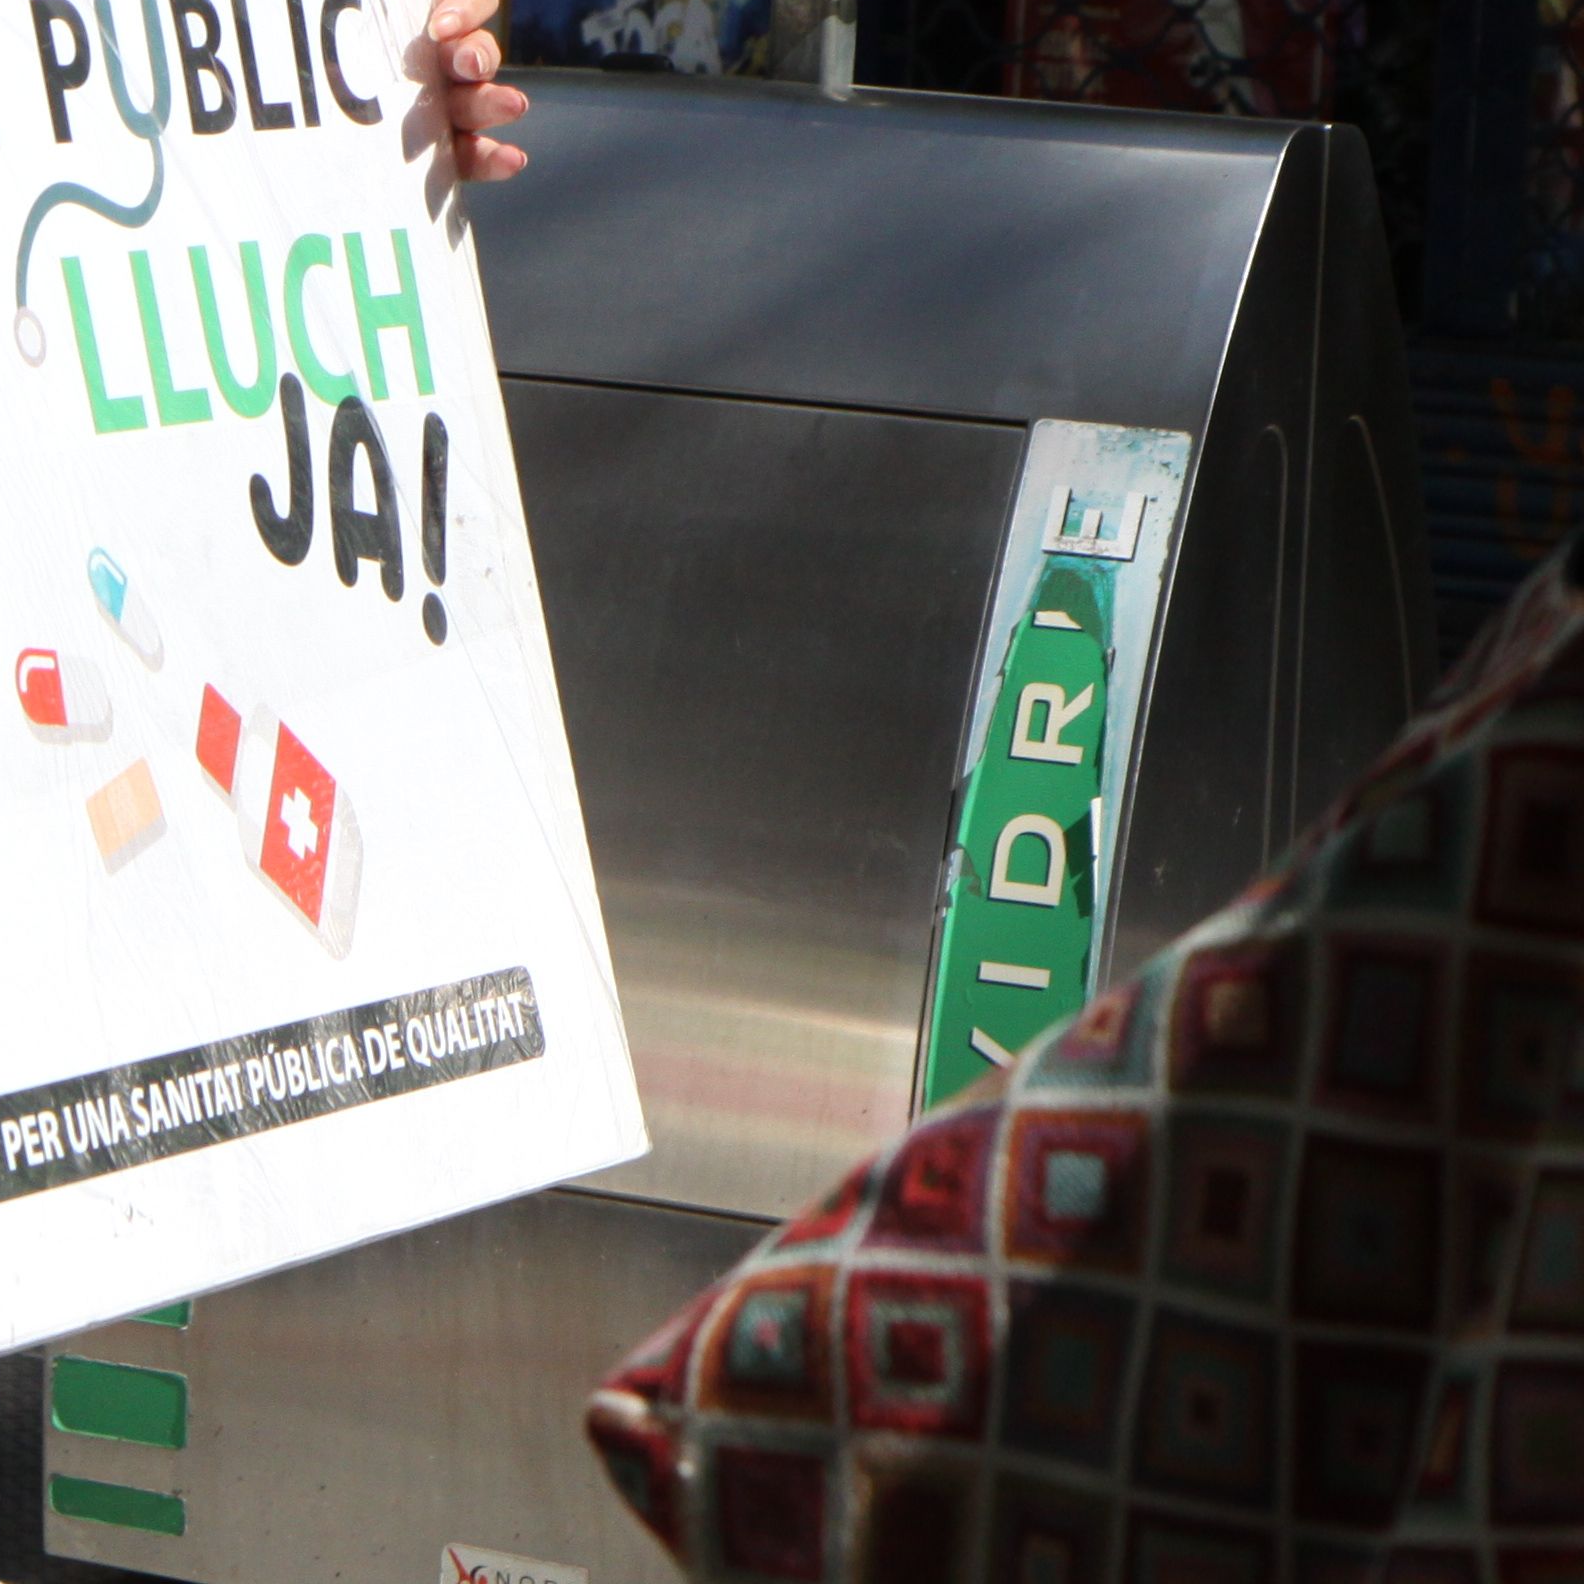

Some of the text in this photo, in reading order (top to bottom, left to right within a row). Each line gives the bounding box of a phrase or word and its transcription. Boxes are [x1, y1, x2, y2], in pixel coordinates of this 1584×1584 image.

[60, 227, 435, 436] LLUCH
[247, 371, 448, 647] JA!
[0, 990, 529, 1171] PER UNA SANITAT PÚBLICA DE QUALITAT
